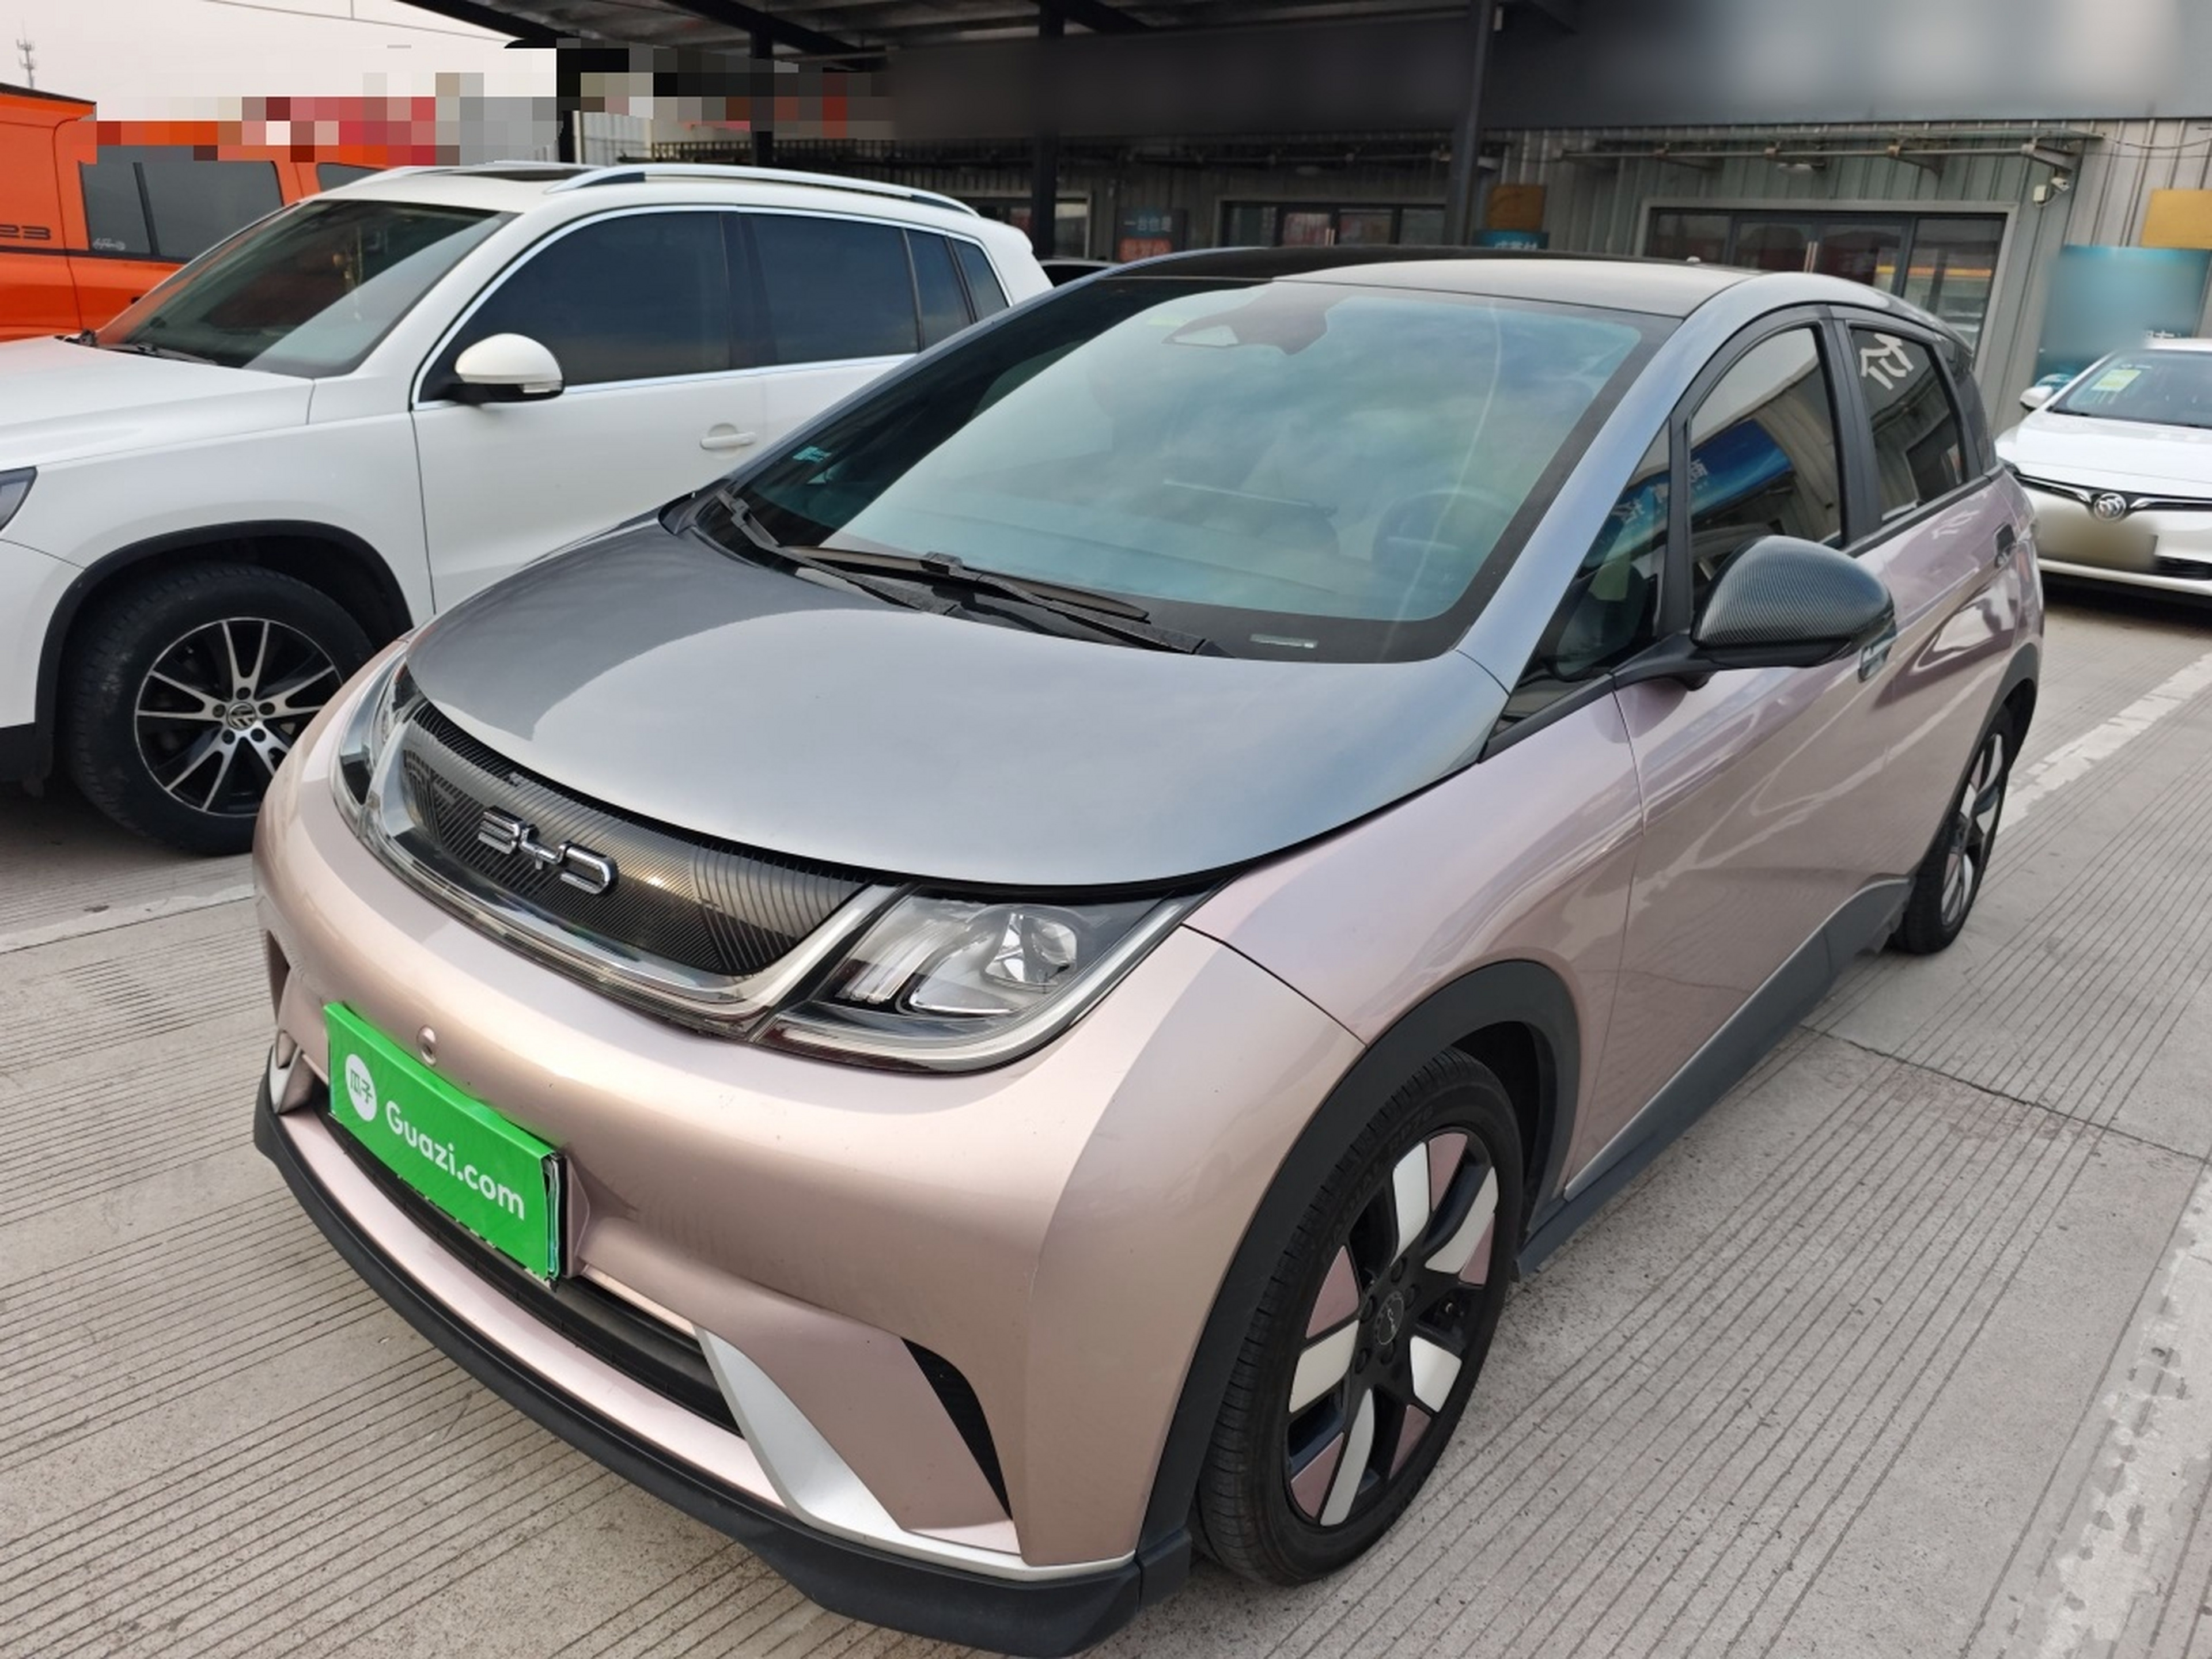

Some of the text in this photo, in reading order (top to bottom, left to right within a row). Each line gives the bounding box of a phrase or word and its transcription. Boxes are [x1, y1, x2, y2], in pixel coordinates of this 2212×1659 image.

[478, 808, 616, 894] BYD
[350, 1068, 373, 1104] 瓜子
[385, 1100, 524, 1221] Guazi.com
